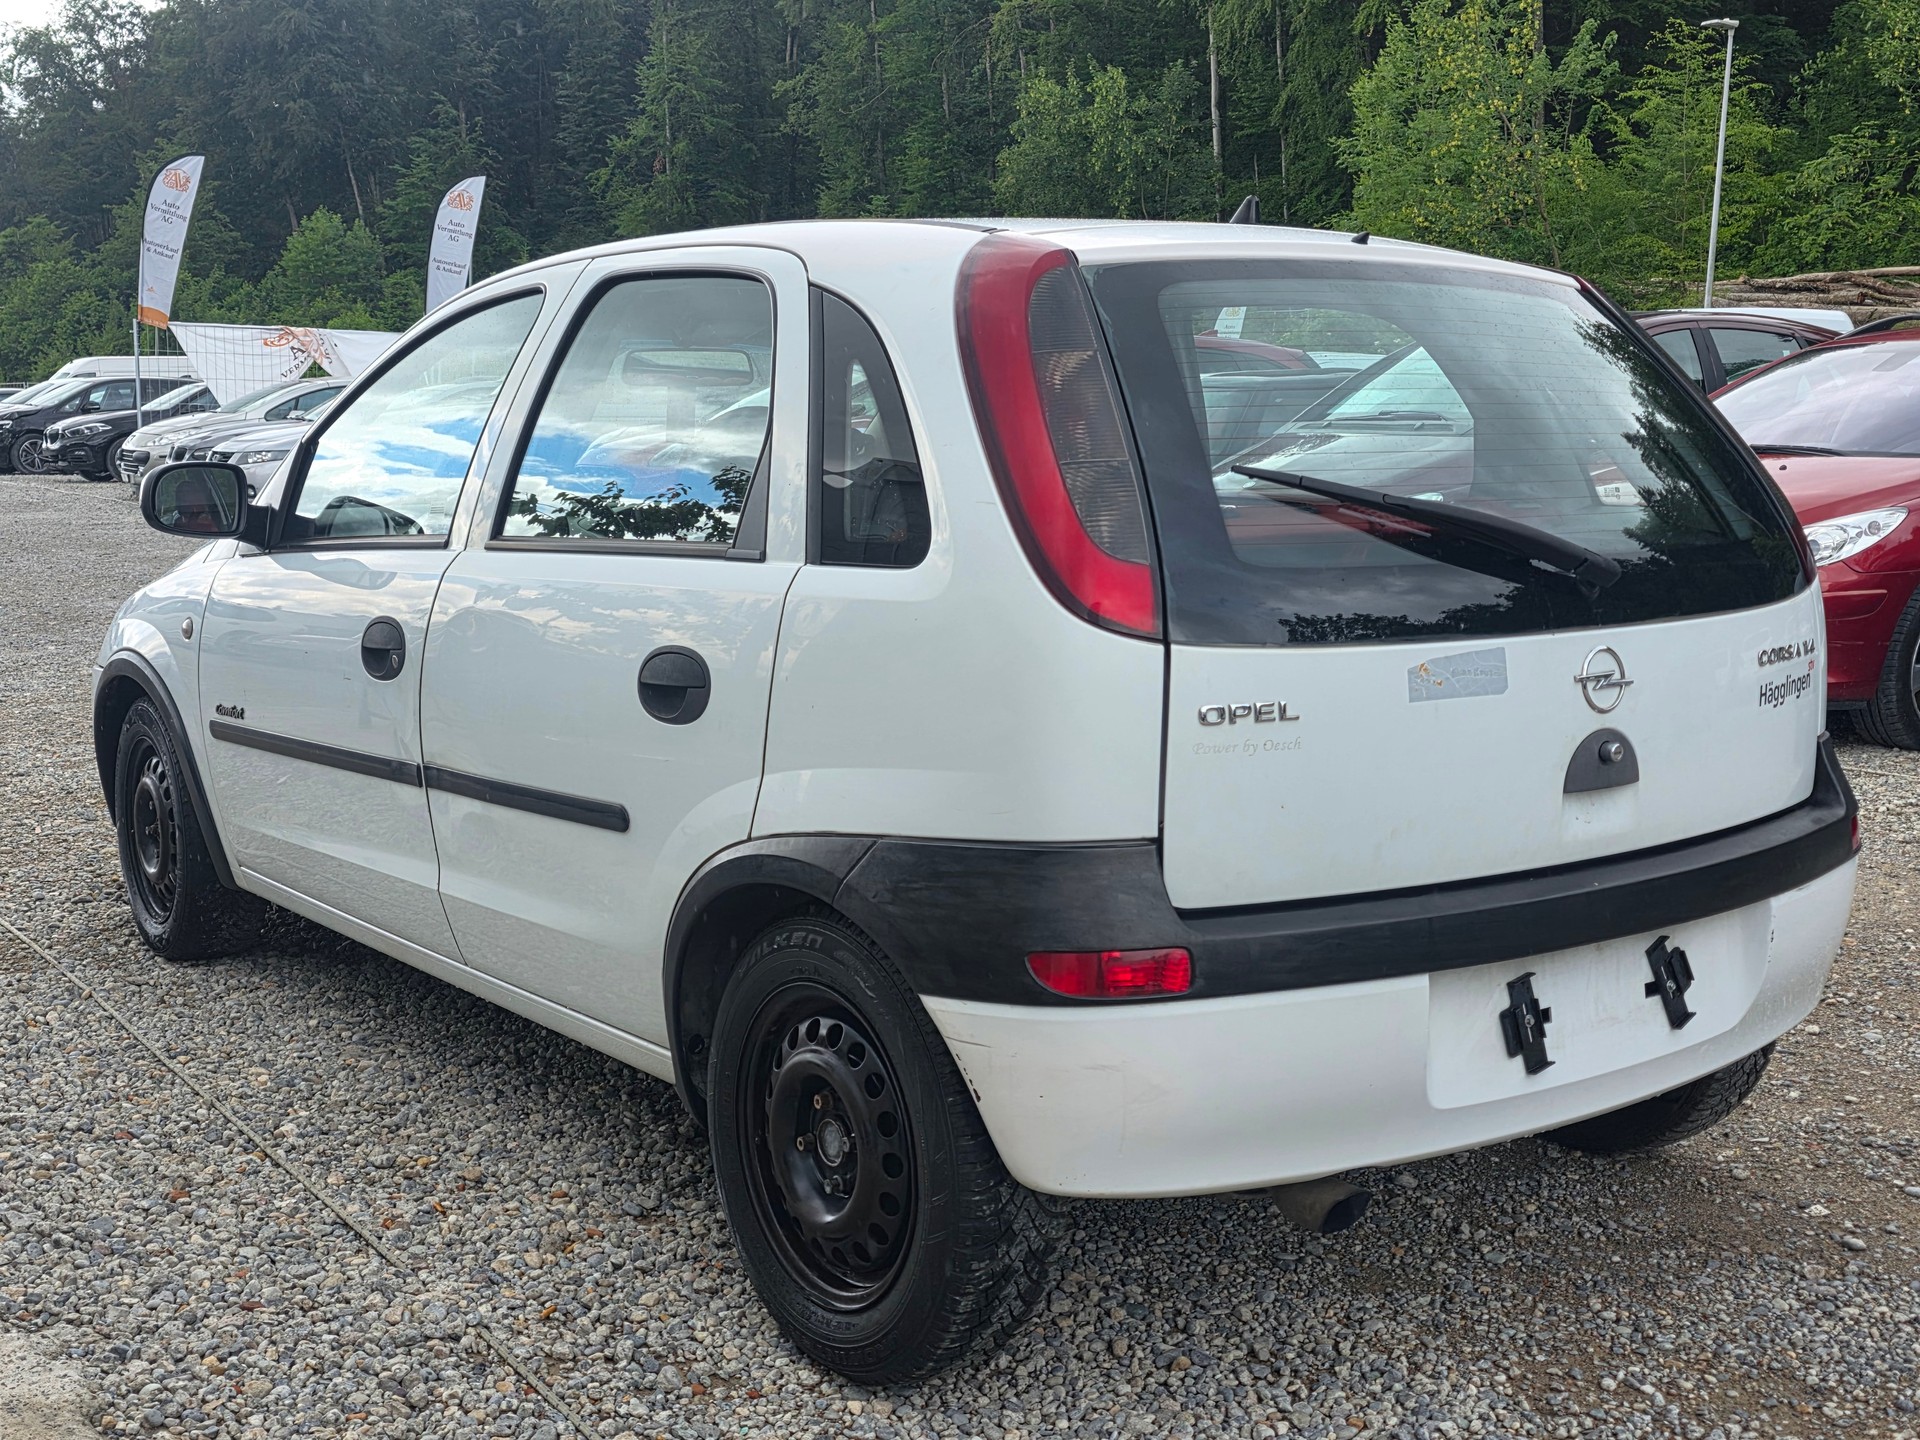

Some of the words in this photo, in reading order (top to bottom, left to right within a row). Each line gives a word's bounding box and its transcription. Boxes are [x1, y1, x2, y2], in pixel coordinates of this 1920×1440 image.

[161, 199, 180, 211] Auto
[150, 203, 188, 223] Vermittlung
[160, 215, 173, 225] AG
[447, 219, 465, 229] Auto
[437, 224, 473, 239] Vermittlung
[447, 235, 460, 243] AG
[152, 248, 175, 260] Ankauf
[432, 257, 467, 270] Autoverkauf
[441, 266, 463, 276] Ankauf
[1758, 642, 1802, 667] CORSA
[1759, 672, 1811, 709] Hägglingen
[1198, 701, 1300, 726] OPEL
[1192, 742, 1239, 755] Power
[1243, 739, 1259, 757] by
[1263, 736, 1303, 752] Oesch
